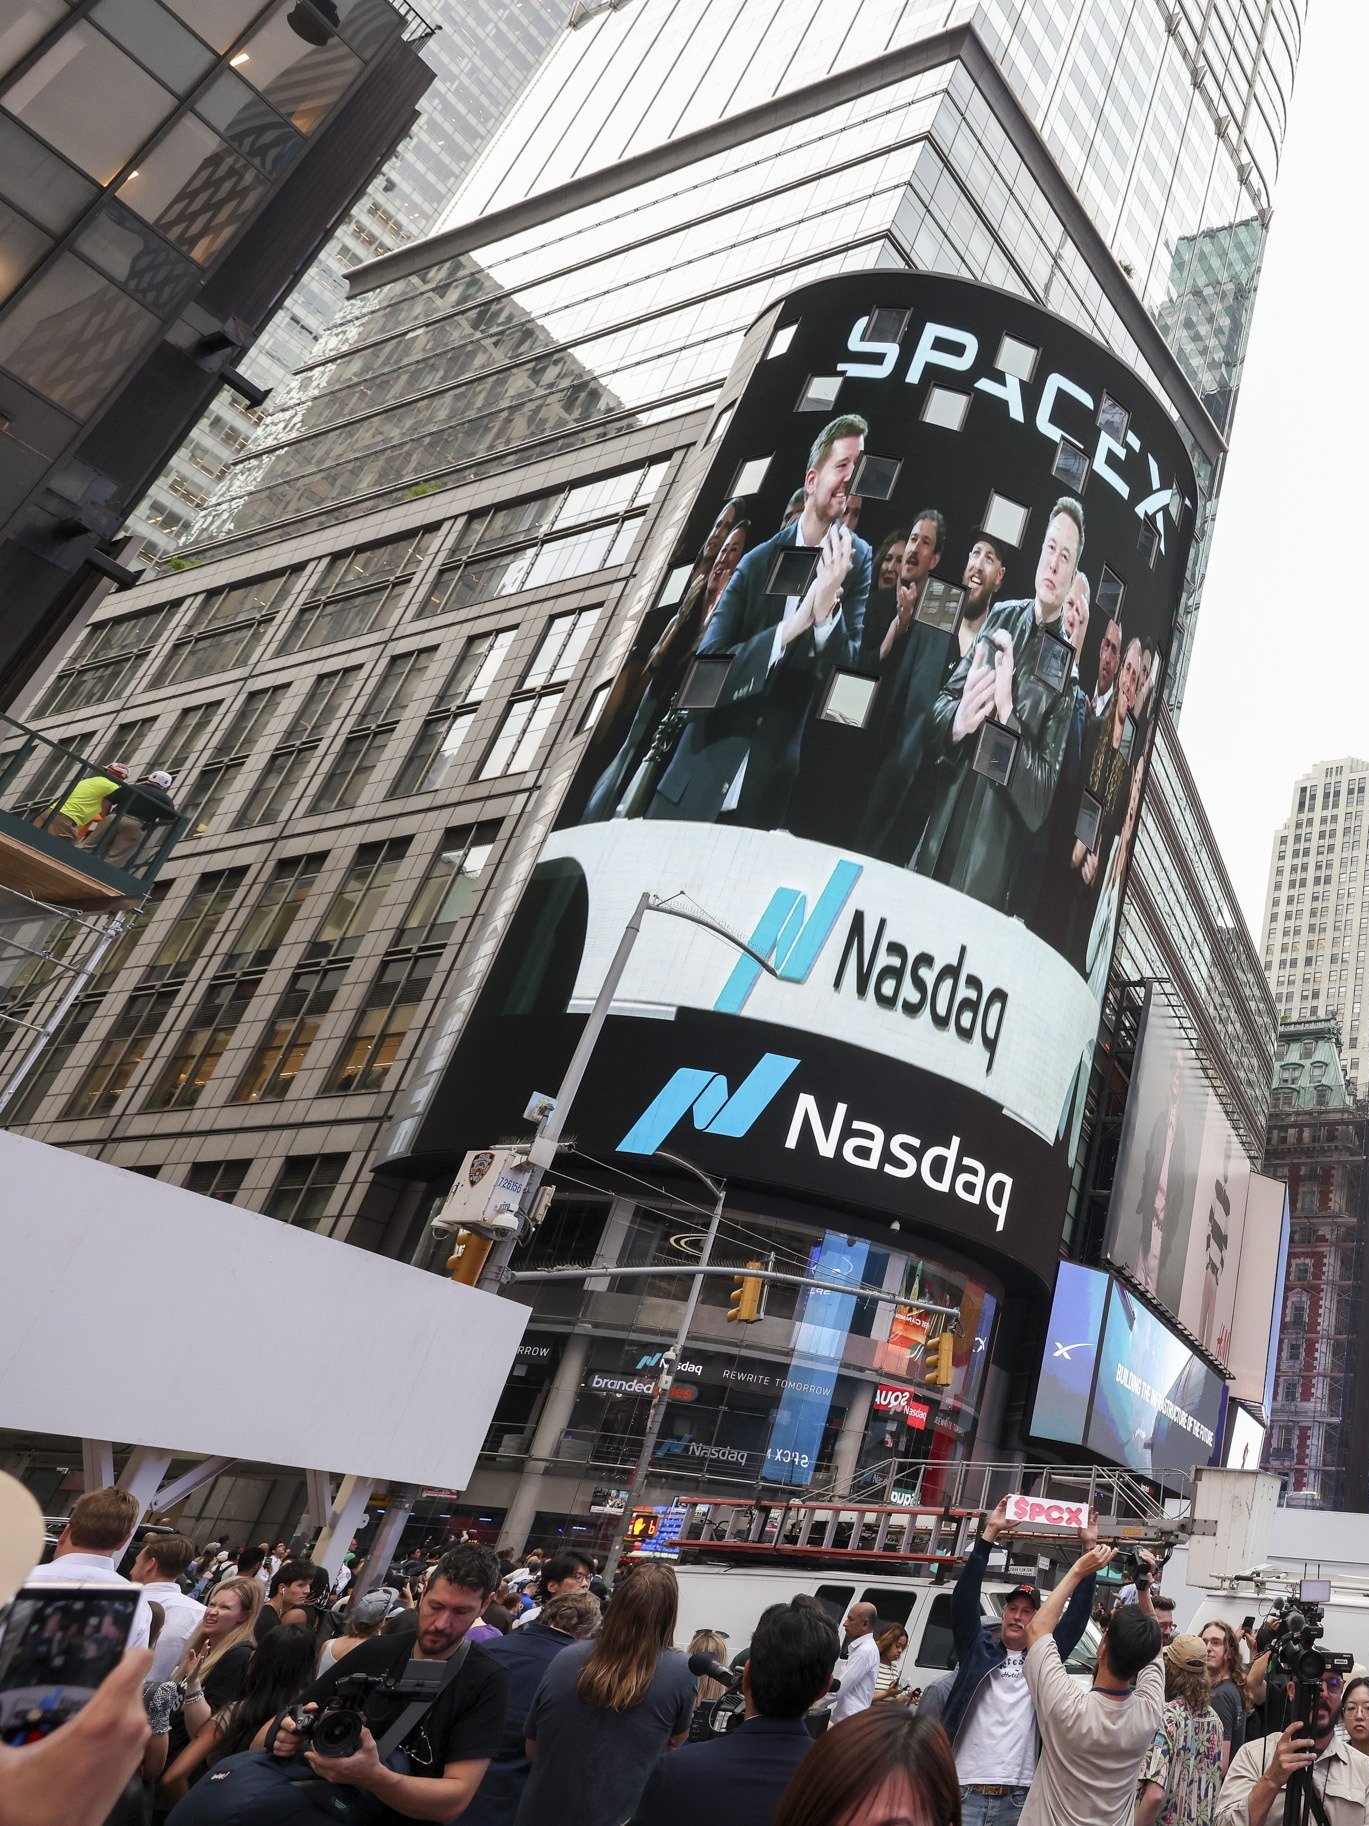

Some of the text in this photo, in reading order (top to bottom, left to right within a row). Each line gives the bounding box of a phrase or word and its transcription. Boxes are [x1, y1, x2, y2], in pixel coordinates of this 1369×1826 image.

[837, 316, 1192, 555] SPACEX
[833, 909, 1008, 1076] Nasdaq
[784, 1093, 1013, 1232] Nasdaq
[658, 1357, 703, 1376] Nsdaq
[723, 1369, 832, 1397] REWRITE TOMORROW
[689, 1442, 748, 1466] Nasdaq
